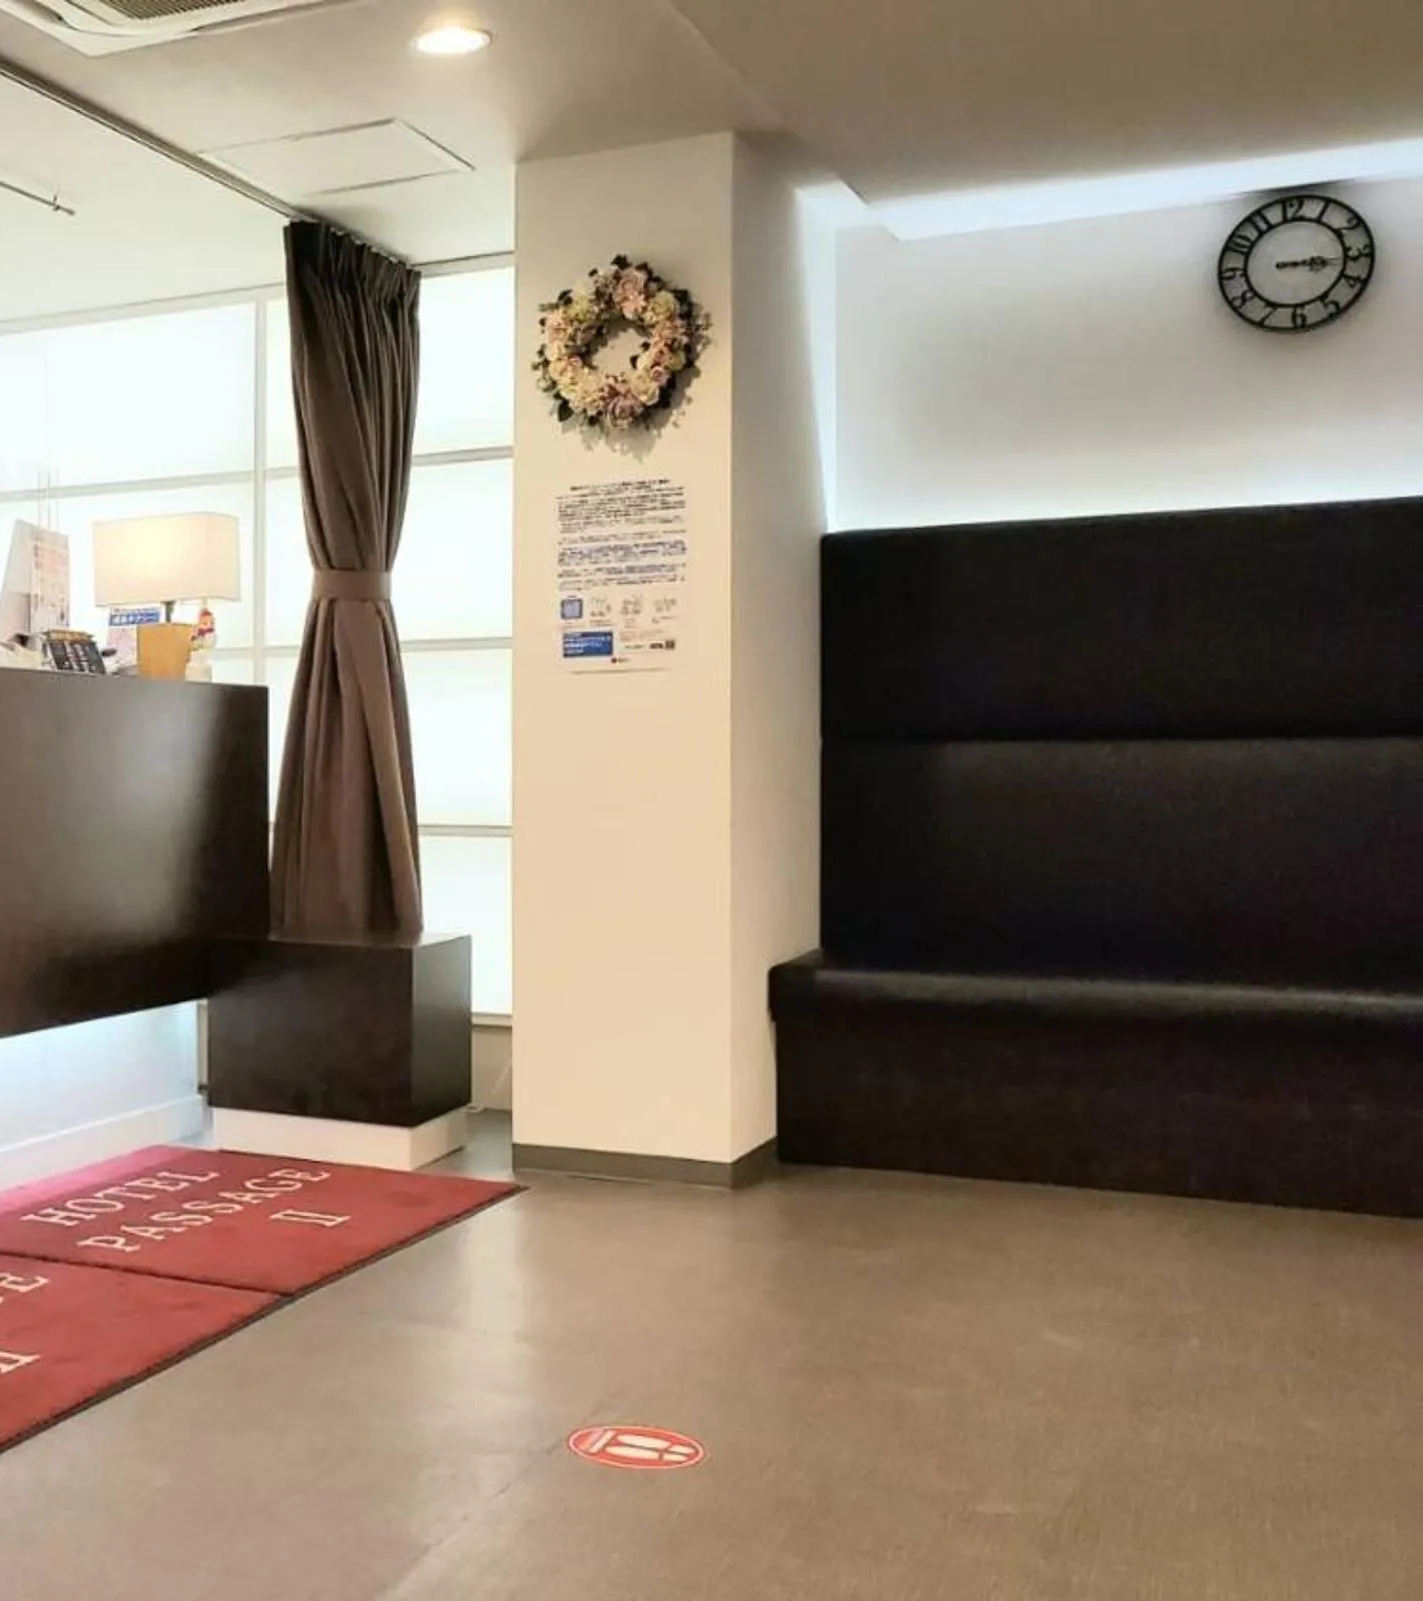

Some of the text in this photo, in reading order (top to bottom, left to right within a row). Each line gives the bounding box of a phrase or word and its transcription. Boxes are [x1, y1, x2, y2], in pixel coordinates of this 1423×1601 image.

[1281, 198, 1305, 221] 12
[1248, 210, 1273, 234] 11
[1337, 214, 1361, 238] 2
[1227, 232, 1254, 255] 10
[1345, 243, 1372, 261] 3
[1231, 289, 1256, 310] 8
[20, 1171, 220, 1226] HOTEL
[77, 1168, 332, 1253] PASSAGE
